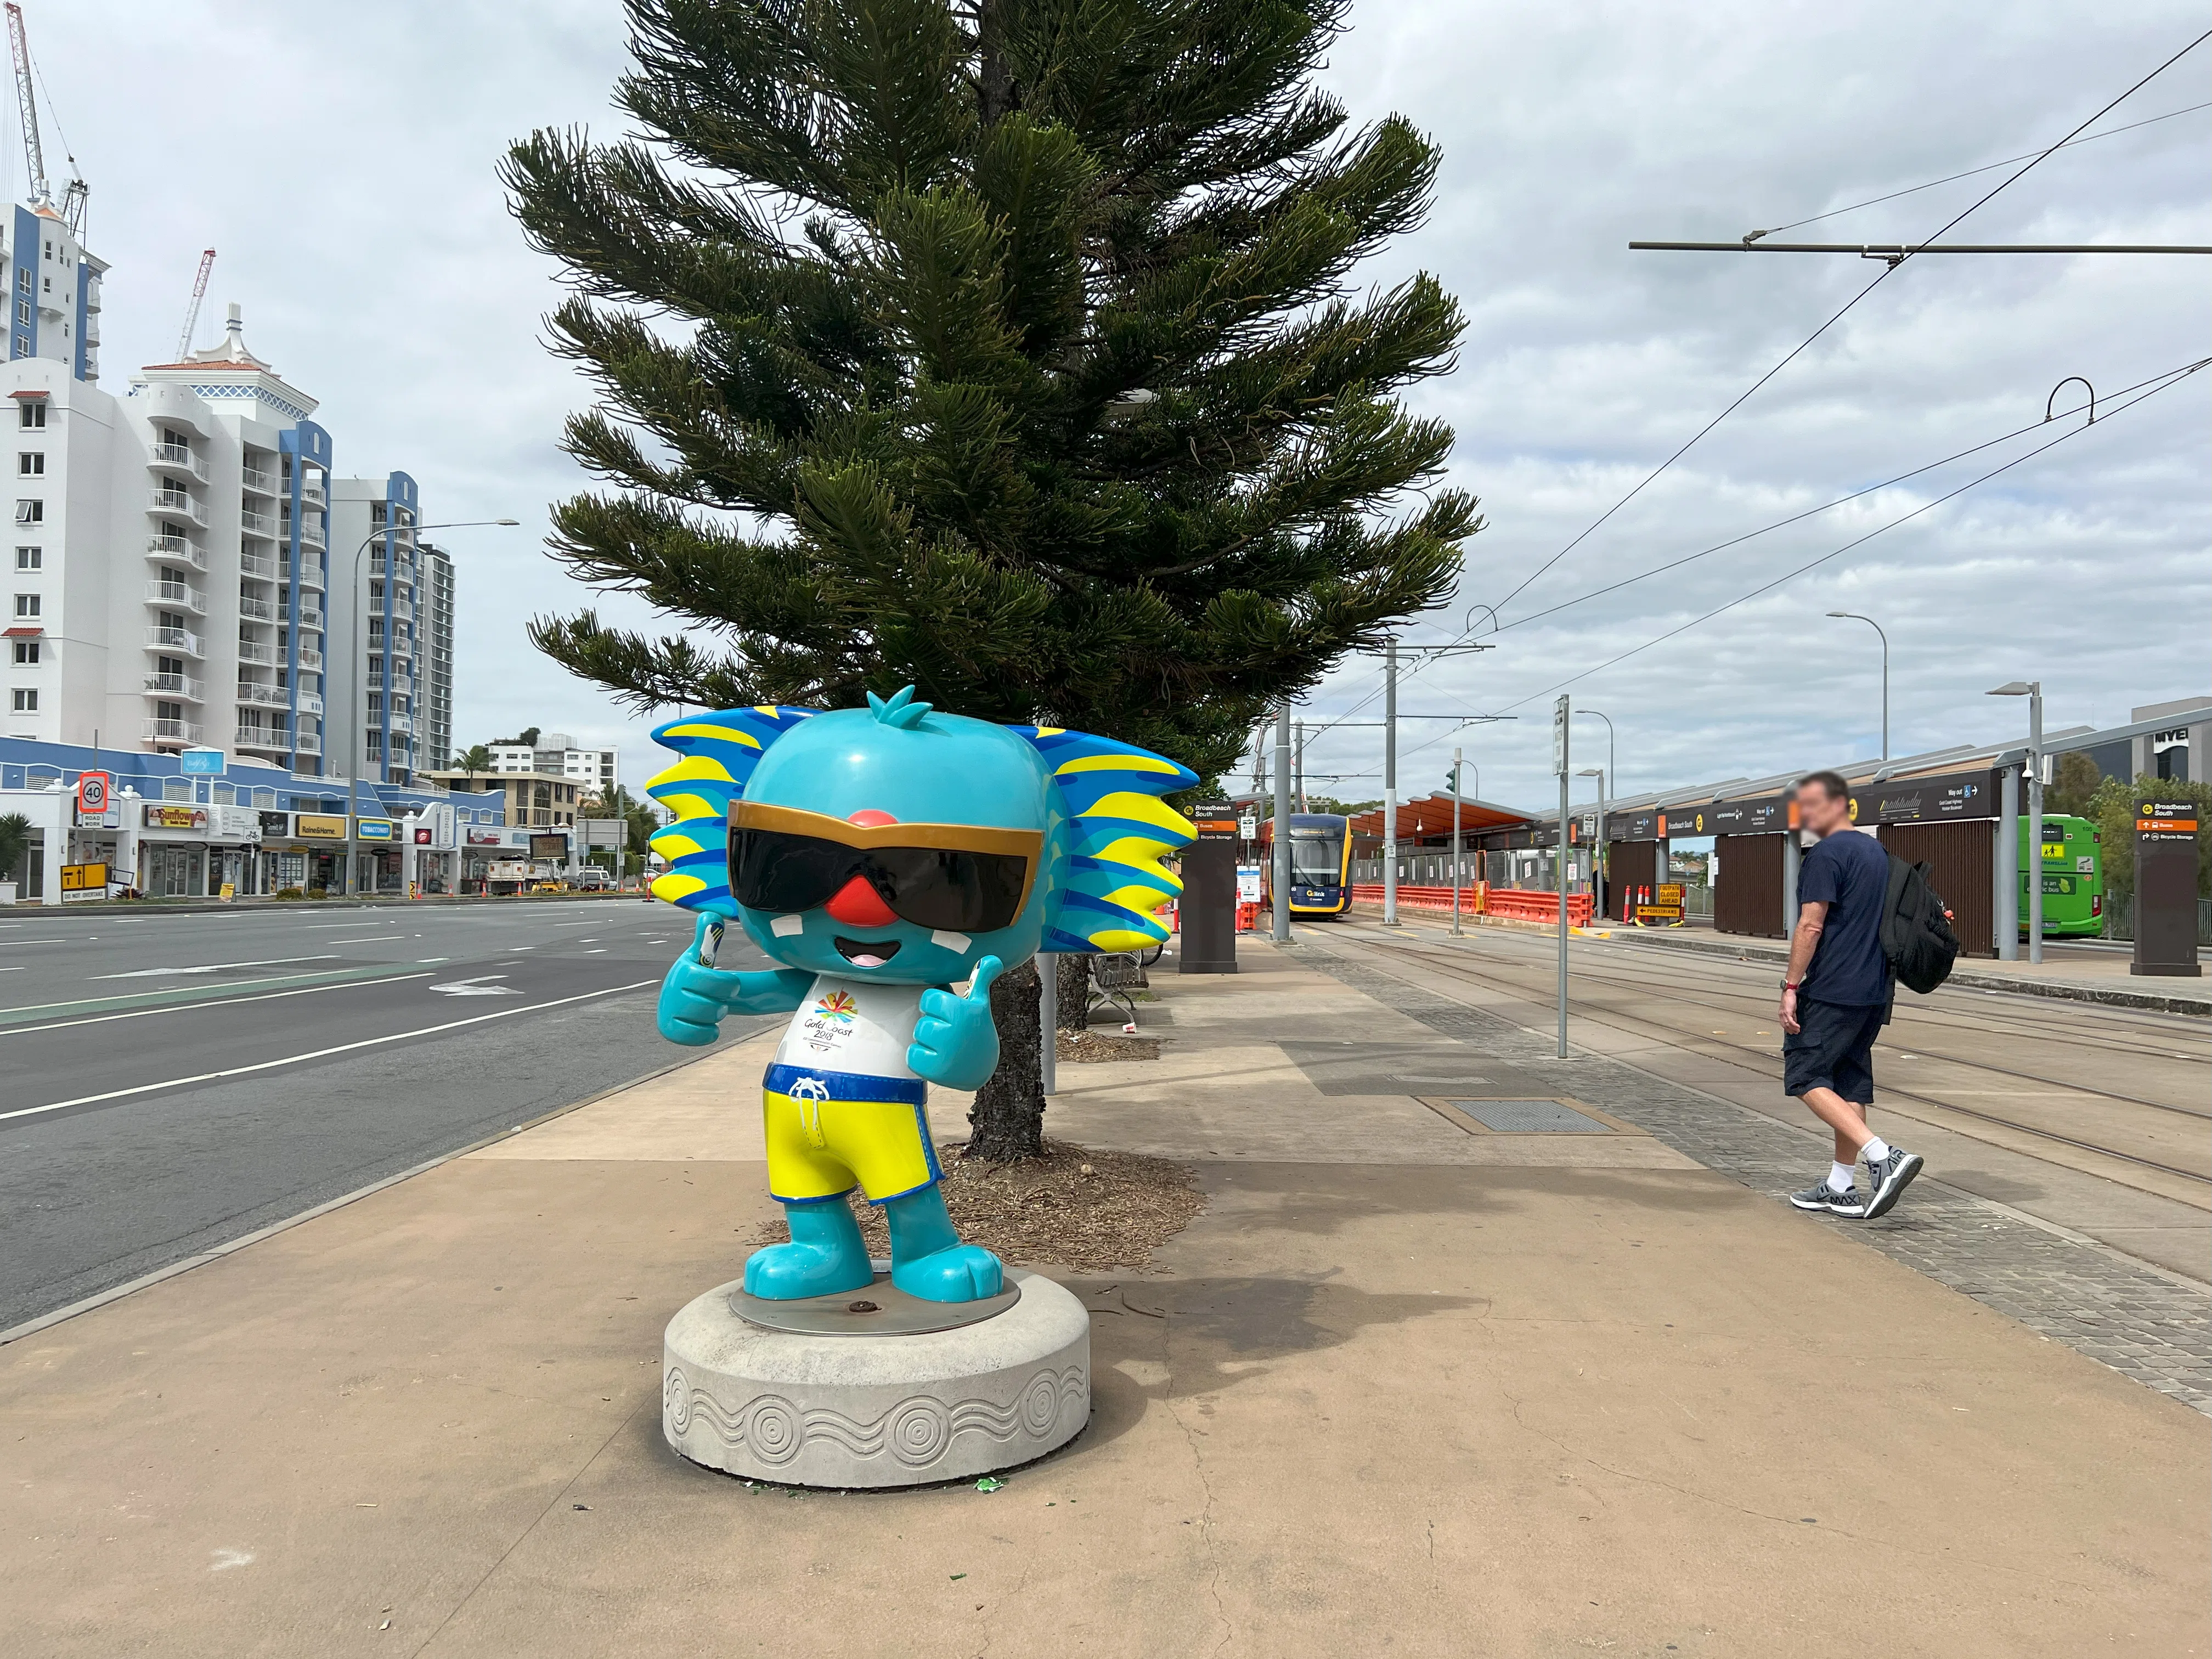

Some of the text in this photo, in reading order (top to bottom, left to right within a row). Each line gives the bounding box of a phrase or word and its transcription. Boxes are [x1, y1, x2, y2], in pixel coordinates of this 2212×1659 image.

[86, 787, 100, 798] 40
[1668, 821, 1684, 830] Broadbeach
[805, 1019, 826, 1030] Gold
[814, 1030, 833, 1041] 2018
[1887, 1149, 1906, 1172] AIR
[1830, 1195, 1857, 1205] MAX
